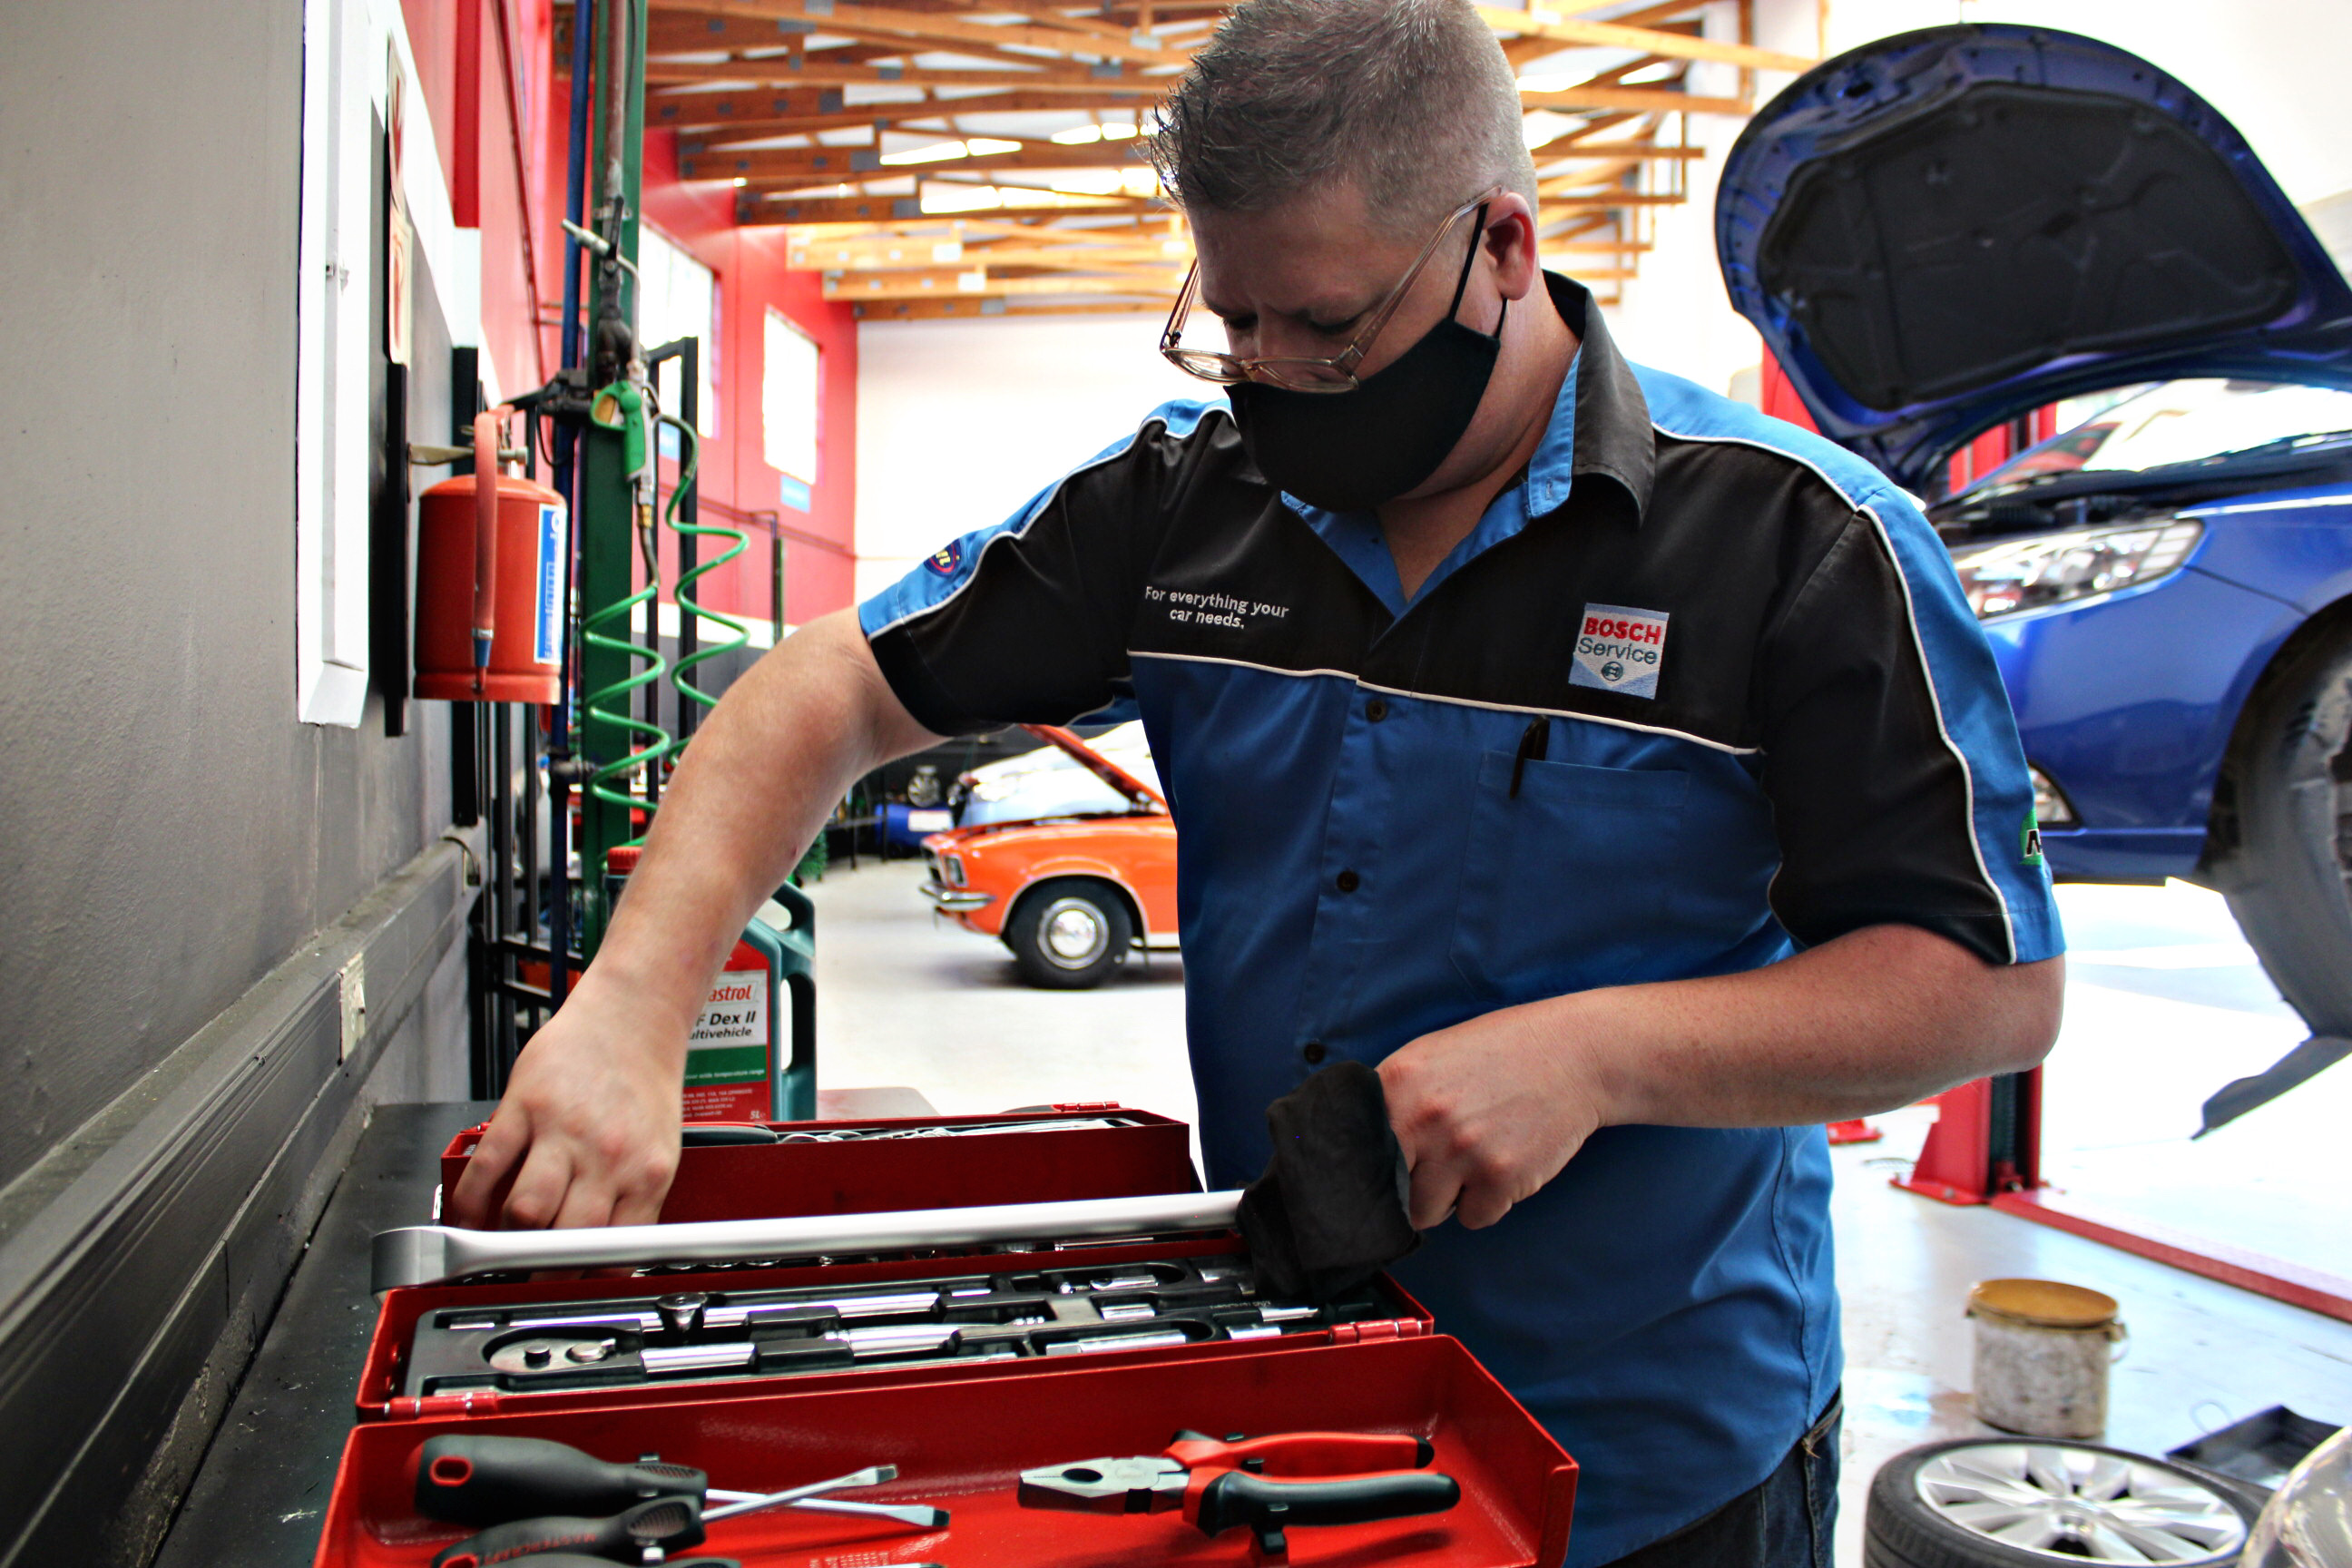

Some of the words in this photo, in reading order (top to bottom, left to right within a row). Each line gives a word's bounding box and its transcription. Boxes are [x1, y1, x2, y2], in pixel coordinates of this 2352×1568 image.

[1145, 586, 1166, 601] For
[1170, 592, 1249, 614] everything
[1250, 602, 1289, 618] your
[1170, 609, 1192, 622] car
[1195, 612, 1244, 629] needs.
[1583, 617, 1661, 645] BOSCH
[1578, 637, 1658, 665] Service
[709, 985, 751, 1002] astrol
[710, 1013, 740, 1026] Dex
[689, 1026, 752, 1040] ultivehicle
[485, 1533, 596, 1566] MASTERCRAFT
